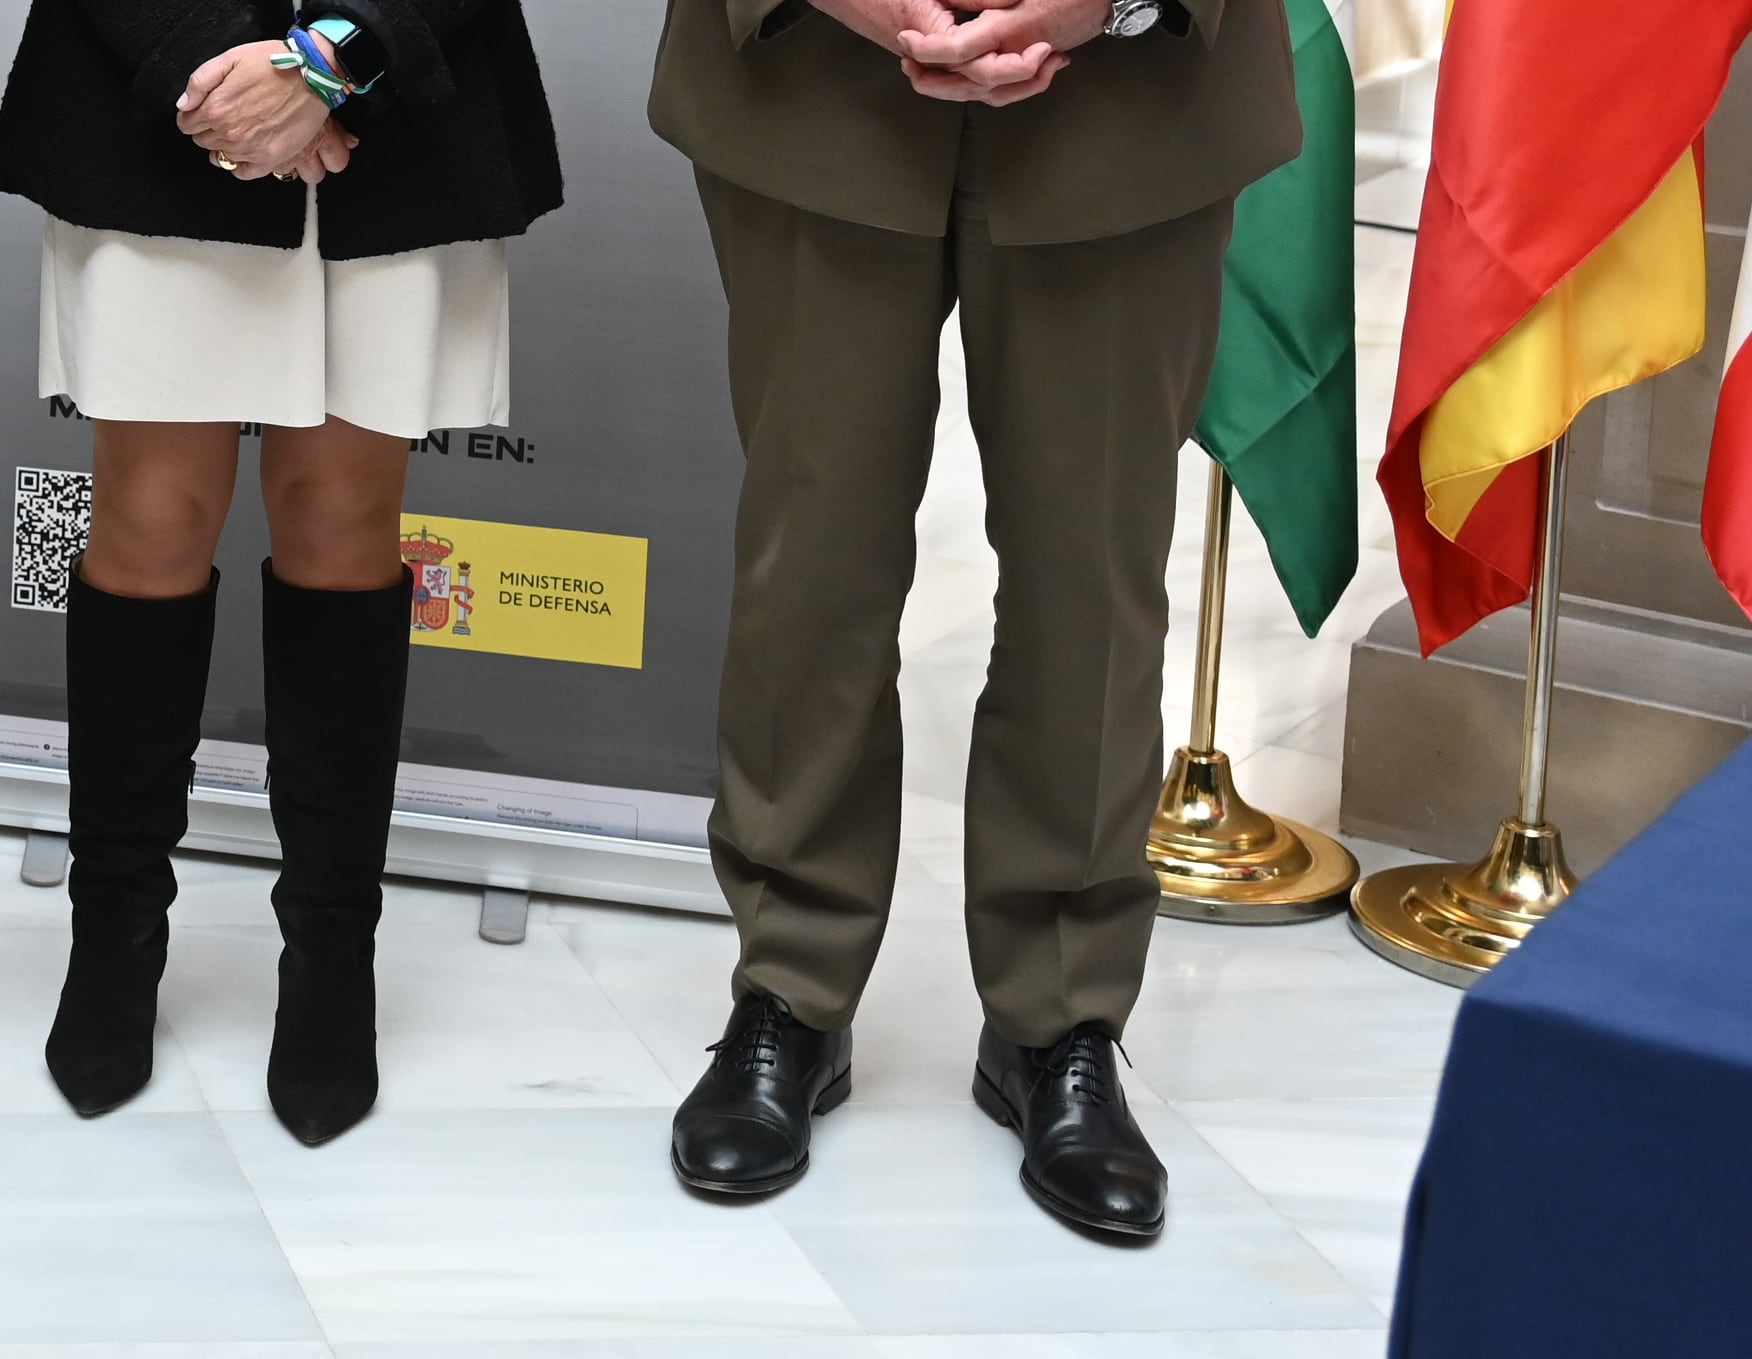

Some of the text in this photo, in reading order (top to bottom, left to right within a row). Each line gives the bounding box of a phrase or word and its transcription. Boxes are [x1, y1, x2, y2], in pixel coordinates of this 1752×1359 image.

[467, 433, 535, 464] EN:
[500, 571, 604, 595] MINISTERIO
[499, 590, 611, 616] DE DEFENSA
